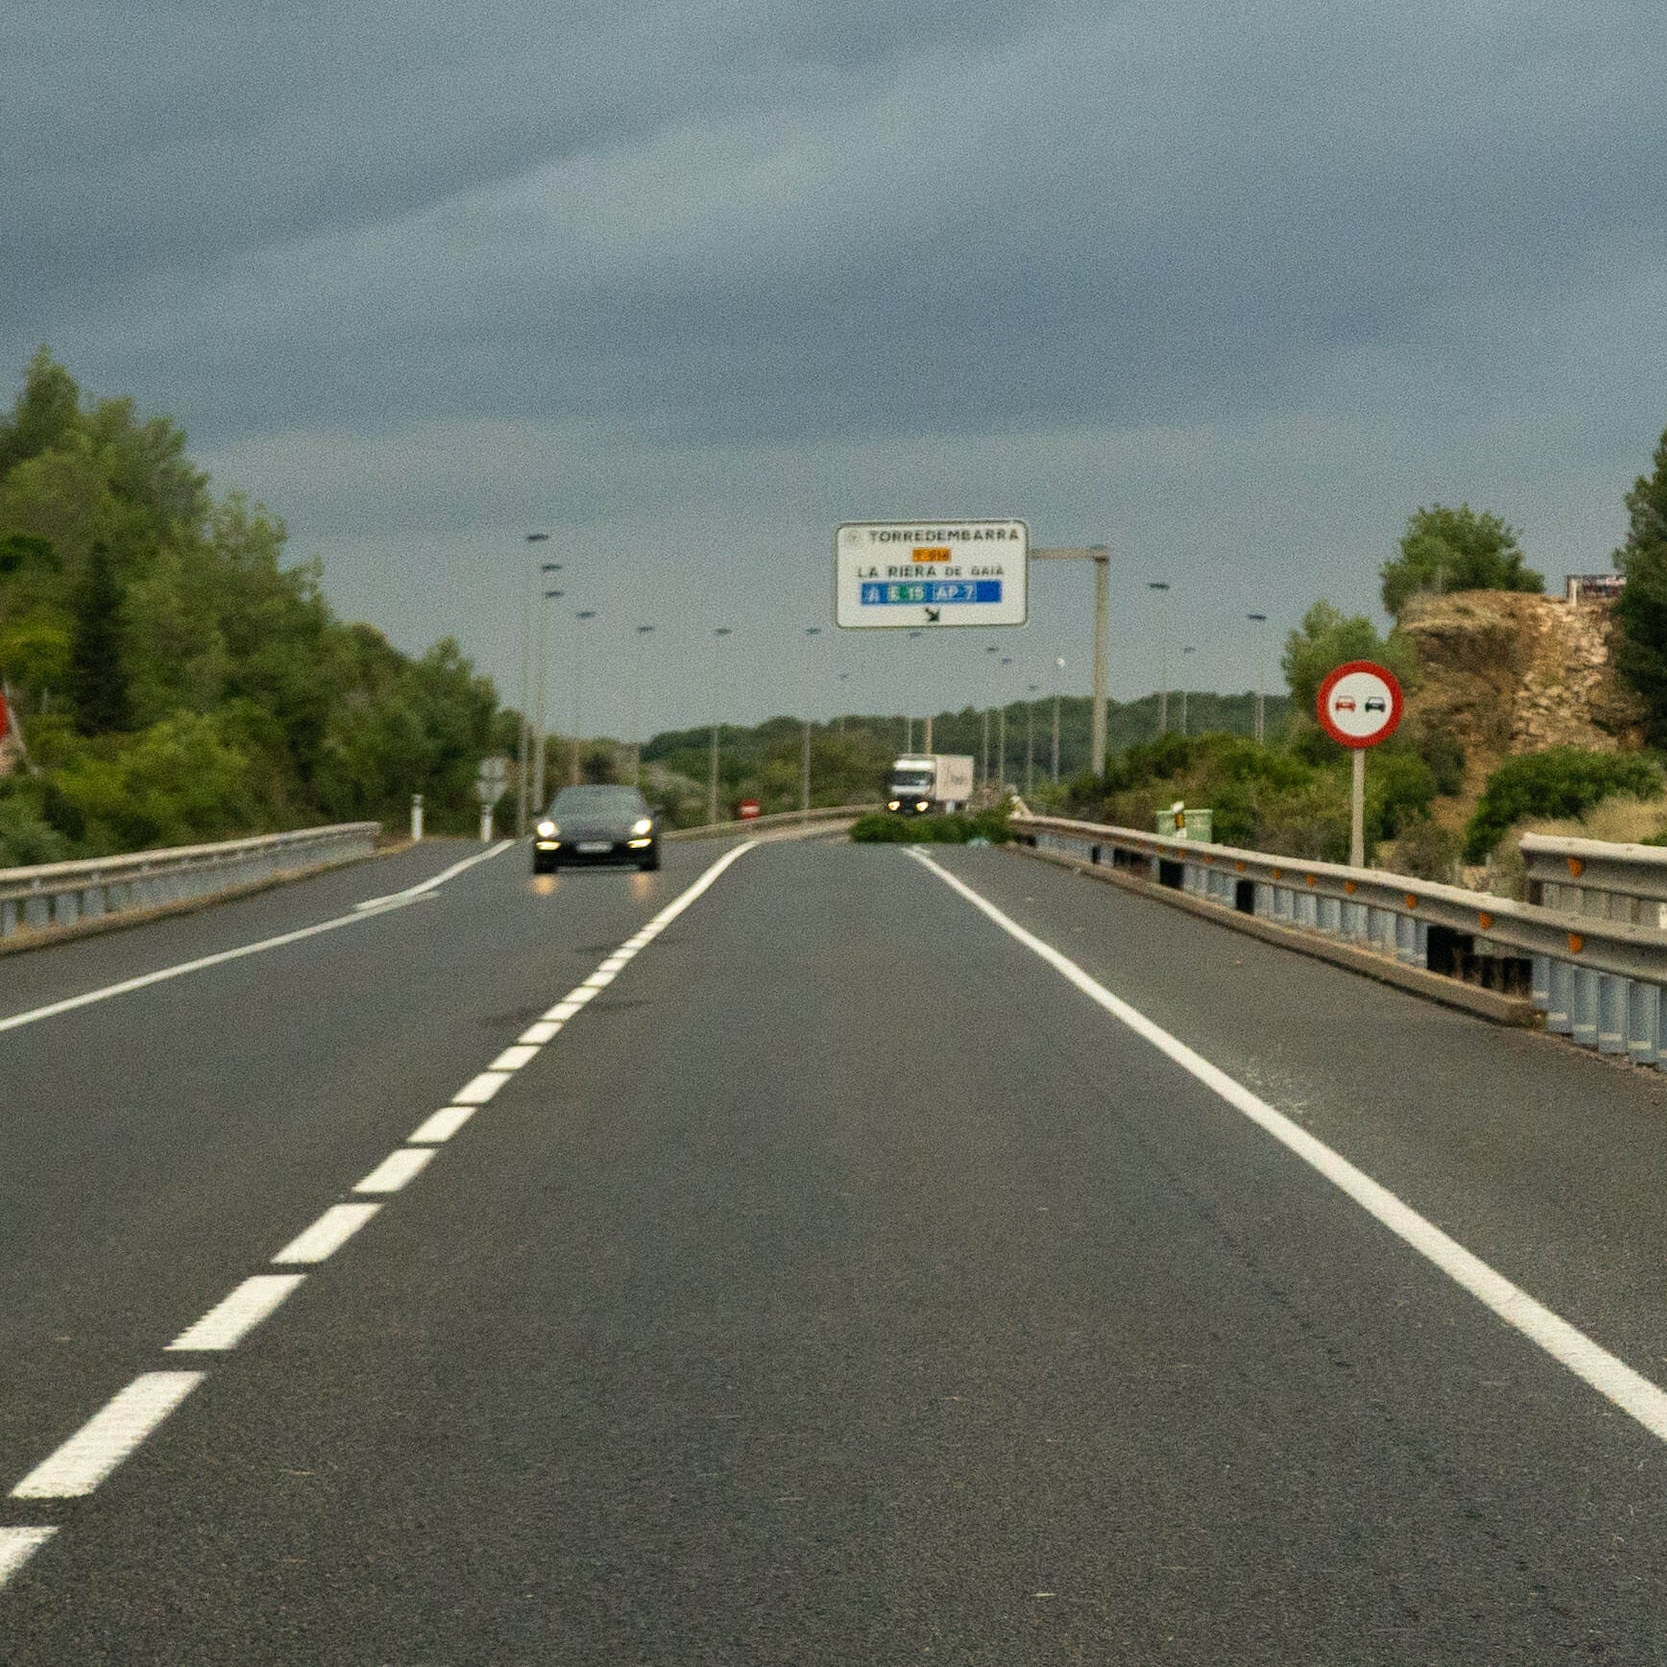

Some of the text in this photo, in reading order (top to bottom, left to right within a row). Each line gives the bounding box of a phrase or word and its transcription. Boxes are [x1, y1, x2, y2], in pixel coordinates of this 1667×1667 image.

[869, 529, 1020, 543] TORREDEMBARRA
[857, 566, 879, 578] LA
[888, 565, 937, 577] RIERA
[945, 566, 962, 576] DE
